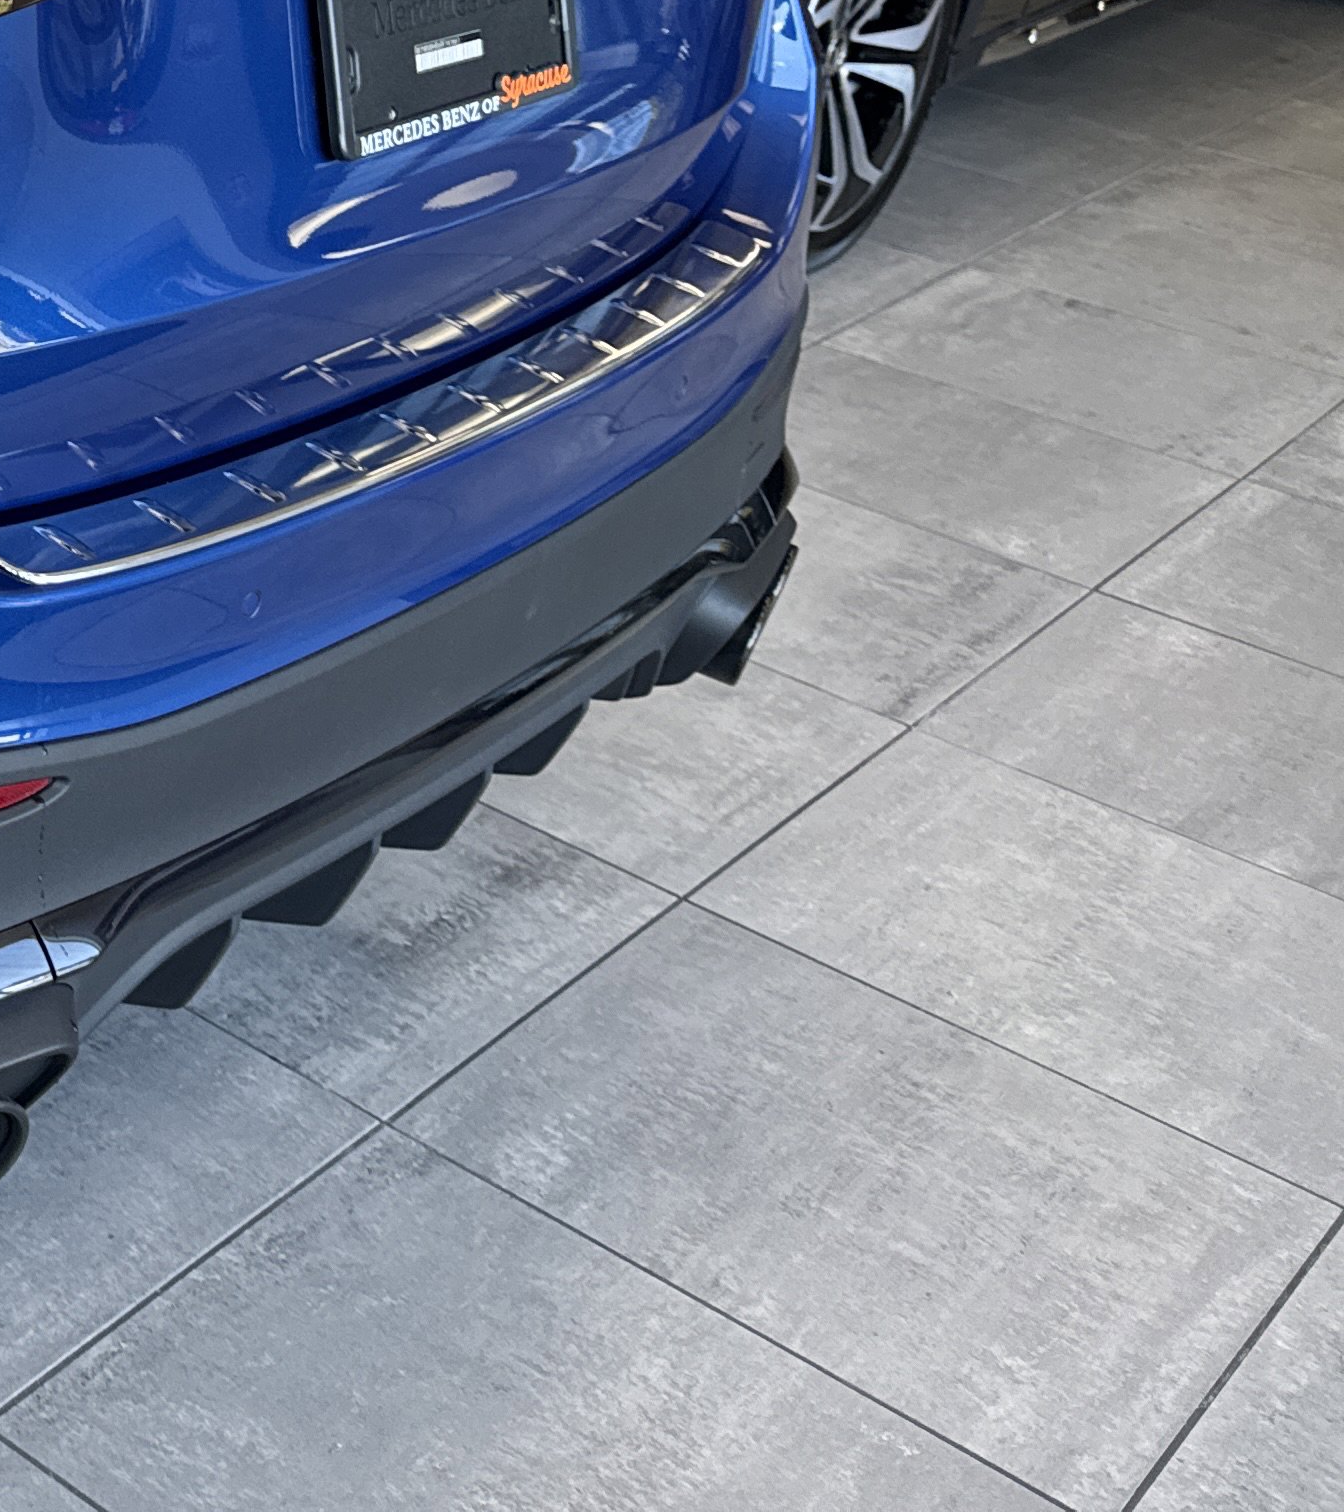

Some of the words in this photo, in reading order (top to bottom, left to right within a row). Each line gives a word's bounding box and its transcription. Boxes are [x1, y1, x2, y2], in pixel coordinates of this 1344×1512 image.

[360, 116, 440, 157] MERCEDES
[441, 102, 481, 130] BENZ
[481, 94, 500, 116] OF
[499, 63, 572, 109] Syracuse
